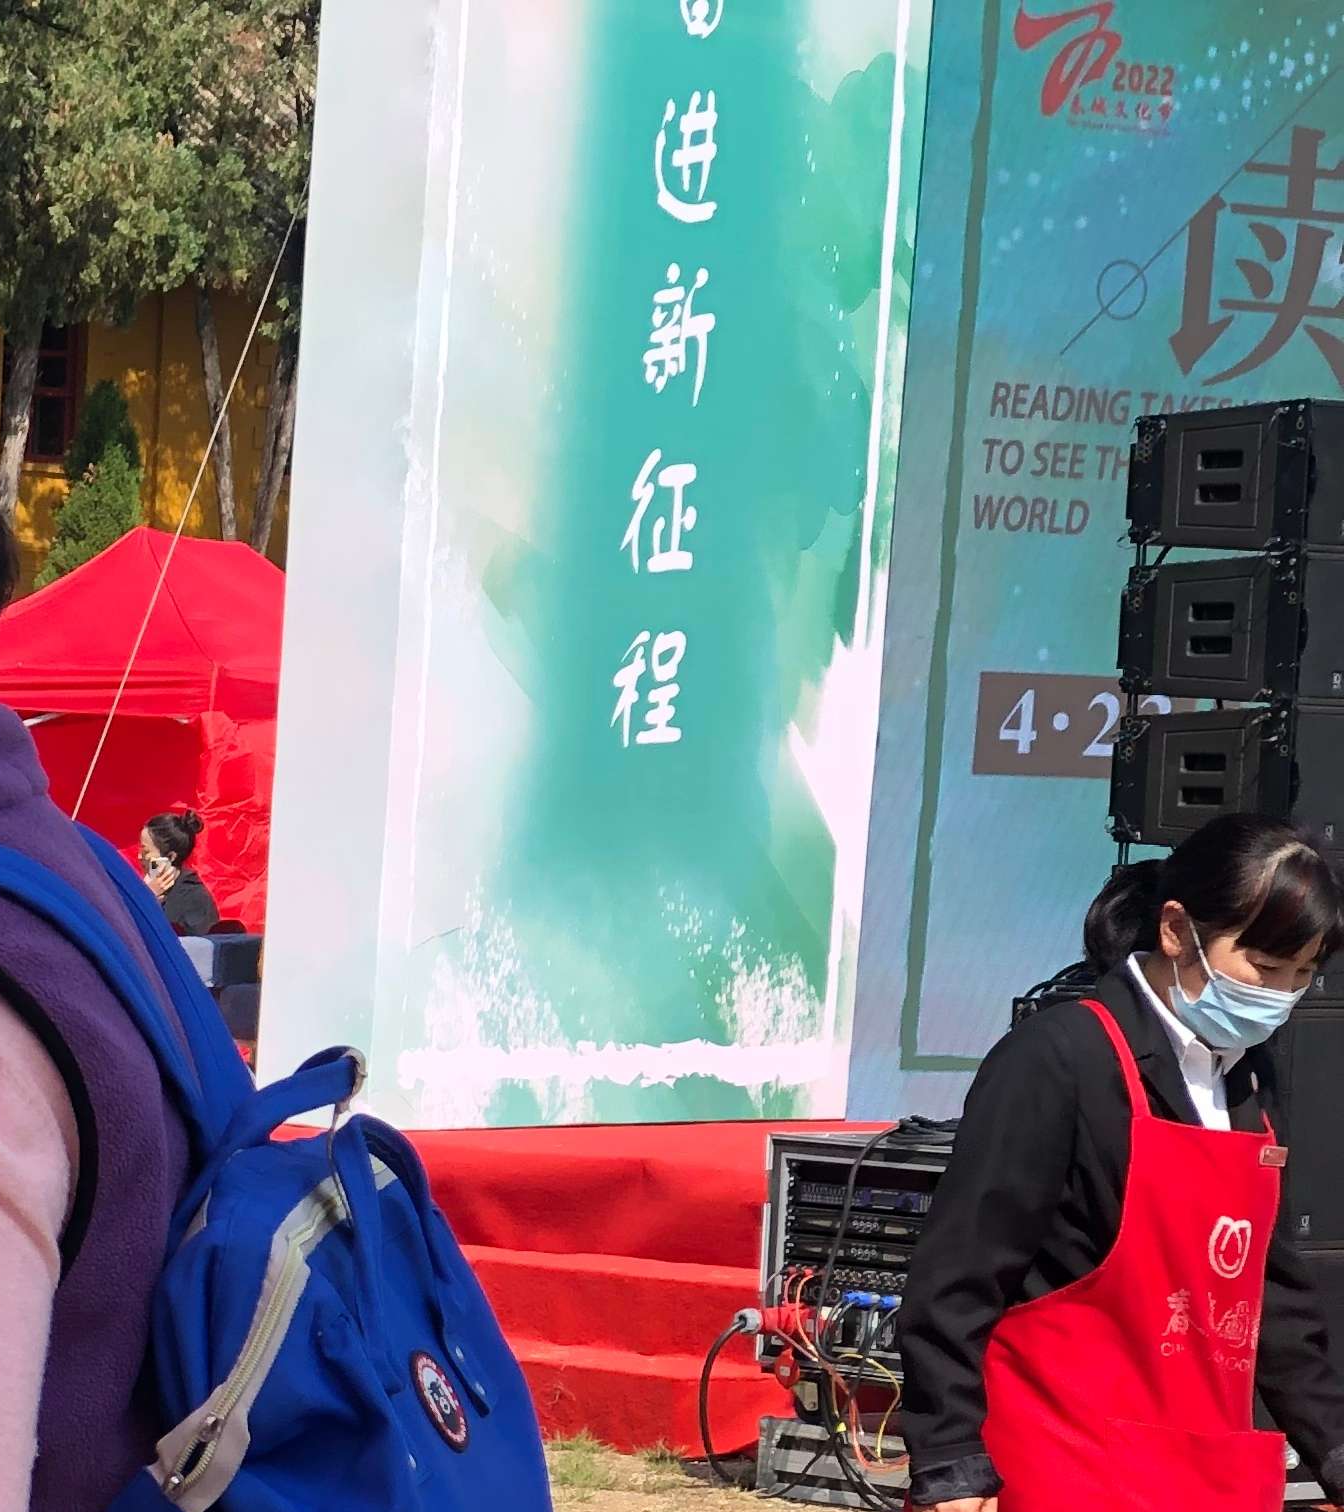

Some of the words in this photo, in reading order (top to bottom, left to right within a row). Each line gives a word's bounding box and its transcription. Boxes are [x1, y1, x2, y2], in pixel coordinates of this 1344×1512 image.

[1112, 61, 1175, 96] 2022
[989, 381, 1133, 426] READING
[981, 438, 1026, 476] TO
[1030, 440, 1093, 481] SEE
[1095, 444, 1130, 482] TH
[973, 494, 1091, 536] WORLD
